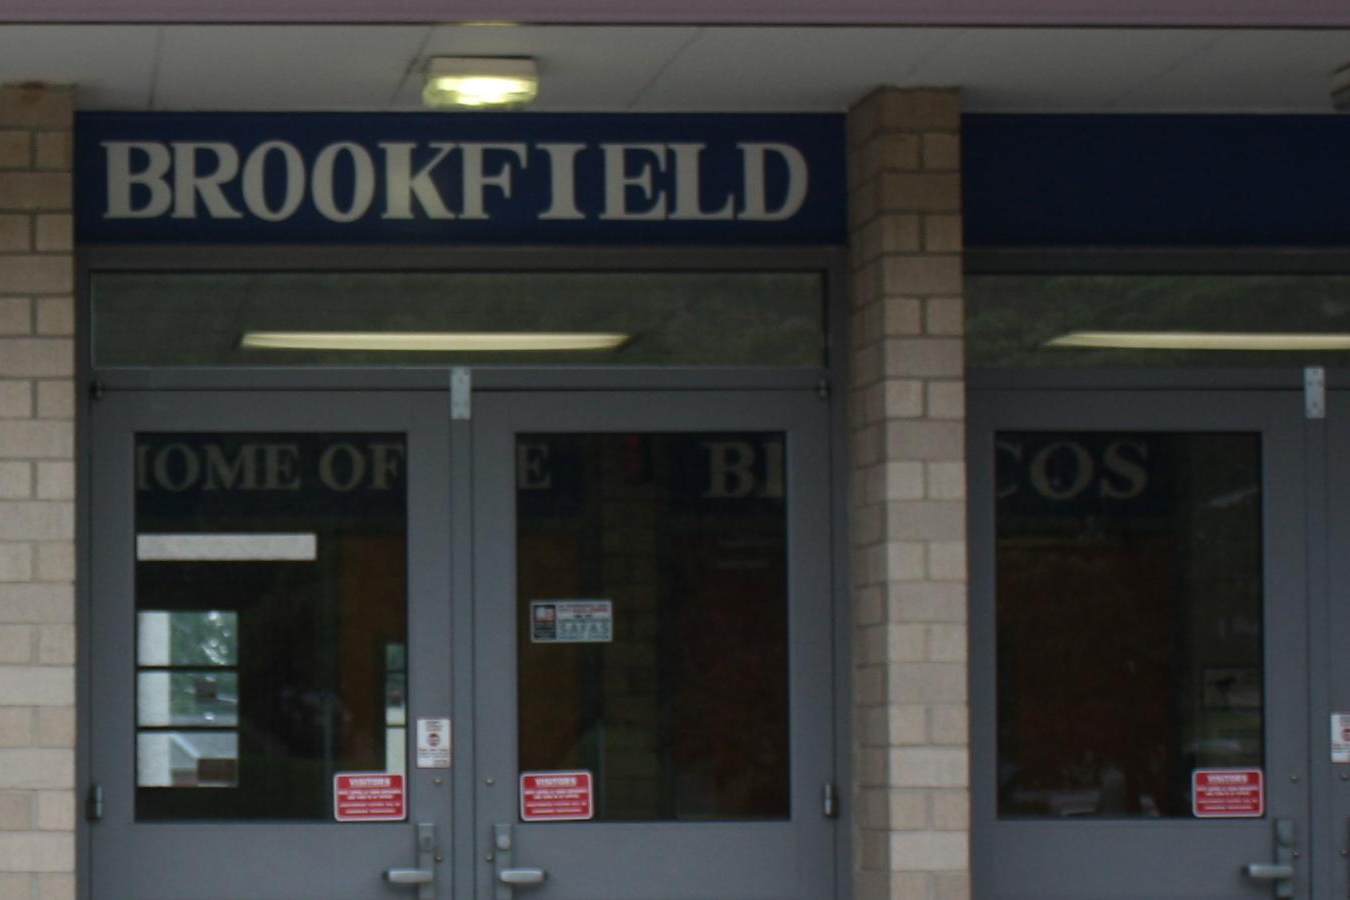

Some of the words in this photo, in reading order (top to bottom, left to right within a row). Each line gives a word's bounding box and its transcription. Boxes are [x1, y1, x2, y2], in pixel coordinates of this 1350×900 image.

[101, 139, 810, 222] BROOKFIELD
[349, 777, 392, 787] VISITORS
[534, 777, 577, 787] VISITORS
